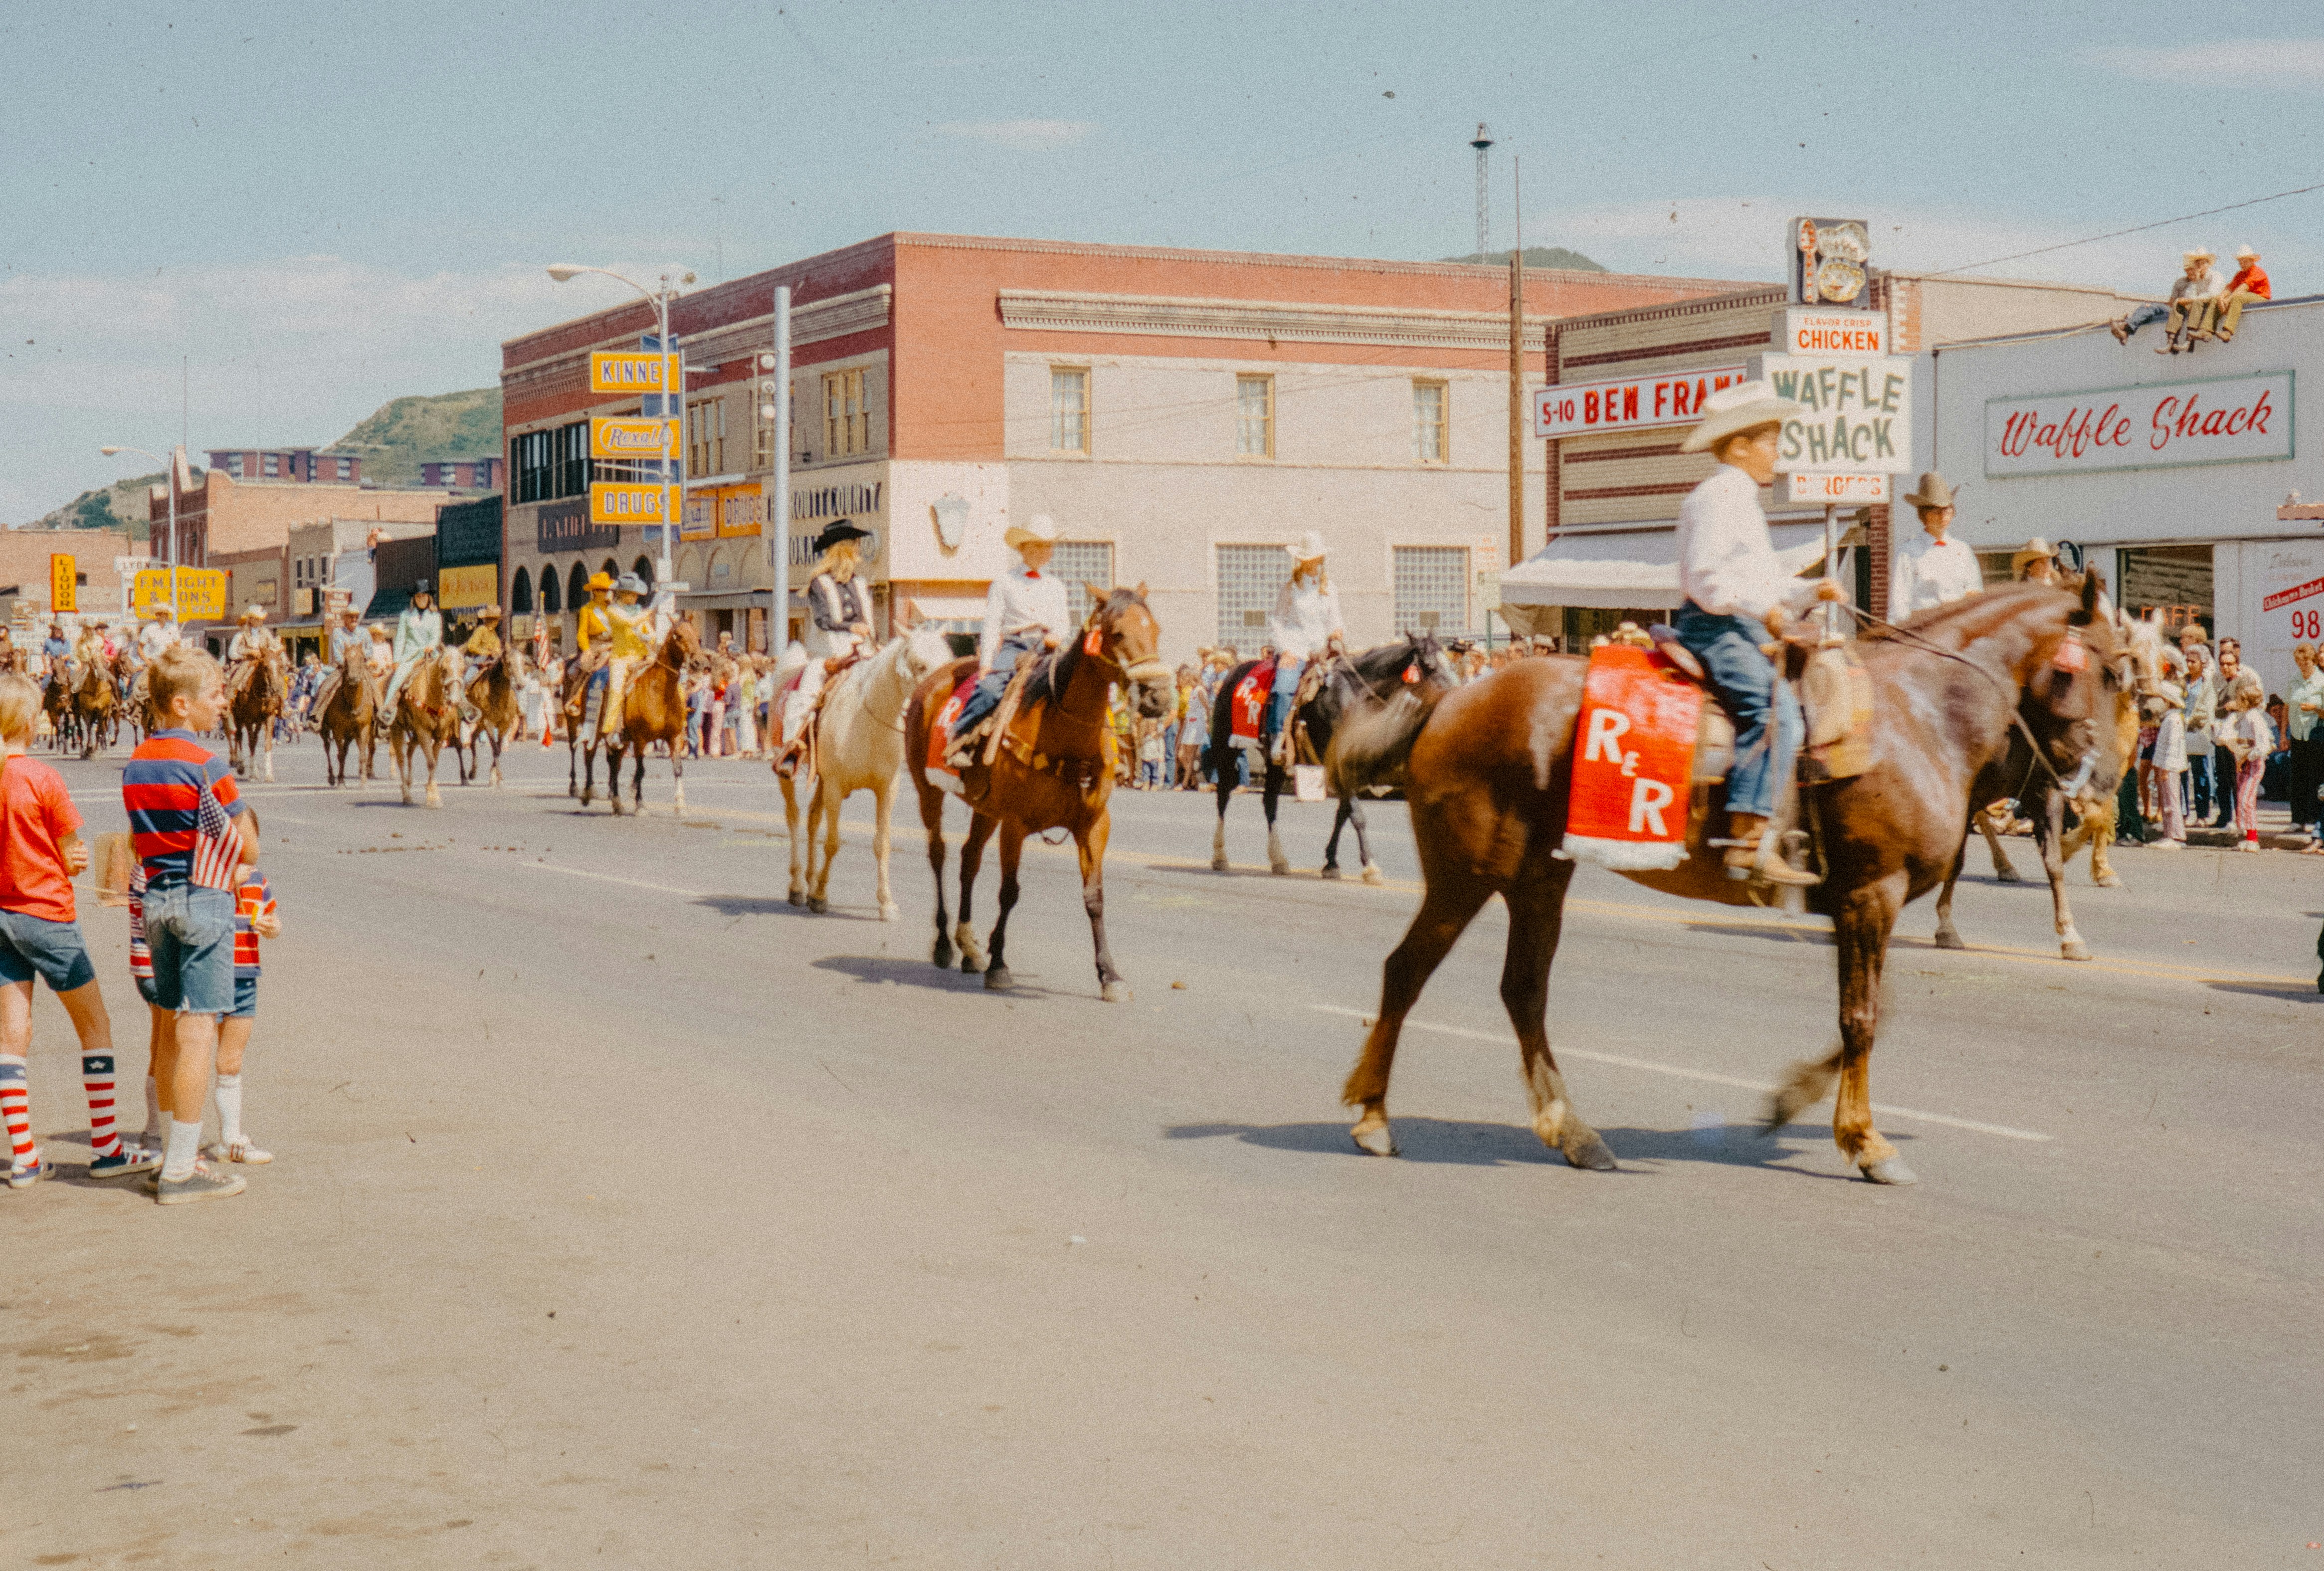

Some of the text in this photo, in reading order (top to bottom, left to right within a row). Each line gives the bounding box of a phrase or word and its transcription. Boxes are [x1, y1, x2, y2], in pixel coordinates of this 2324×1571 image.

[1798, 329, 1879, 351] CHICKEN
[1804, 317, 1872, 327] FLAVOR CRISP
[601, 361, 671, 384] KINNE
[1772, 366, 1903, 412] WAFFLE
[1543, 373, 1744, 425] 5-10 BEN FRA
[608, 426, 665, 448] Rexall
[1782, 415, 1896, 463] SHACK
[2001, 389, 2272, 458] Waffle Shack
[725, 492, 762, 527] DRUGS
[59, 559, 70, 607] LIQUOR
[170, 576, 219, 589] IGHT
[2292, 610, 2321, 639] 98
[1585, 708, 1631, 764] R
[1628, 777, 1674, 836] R
